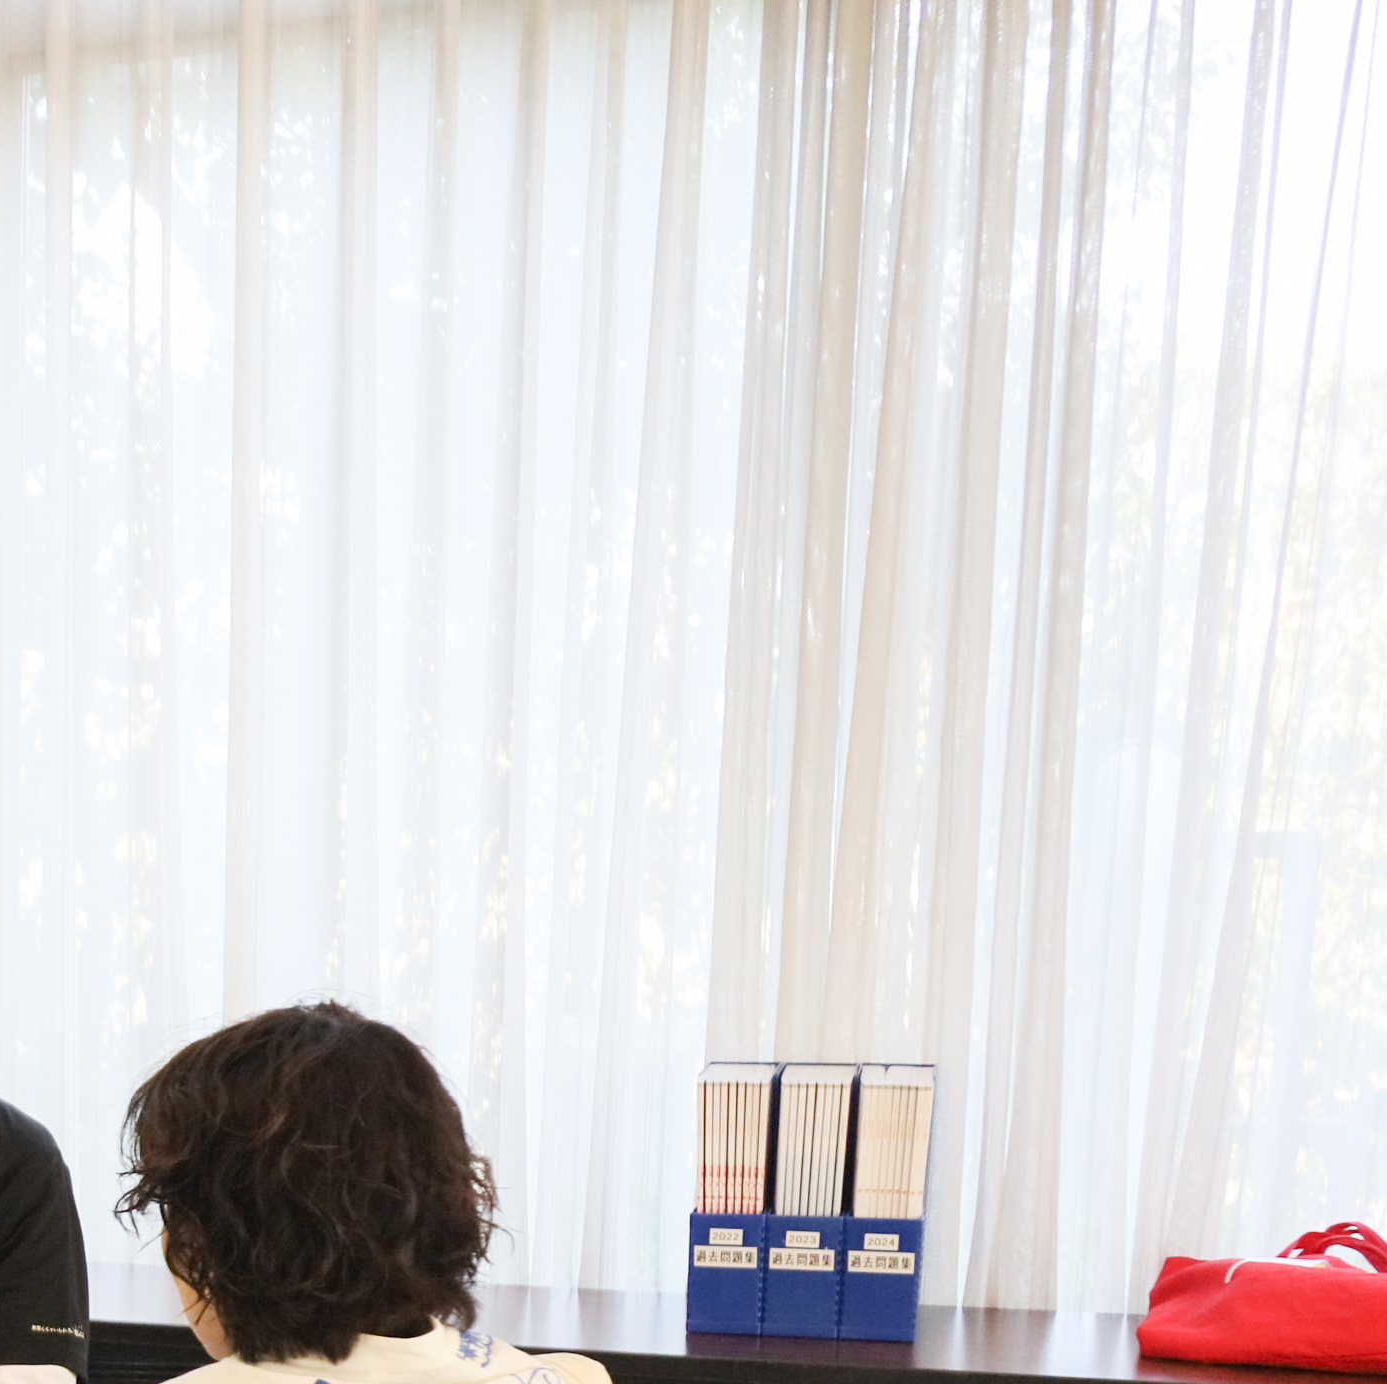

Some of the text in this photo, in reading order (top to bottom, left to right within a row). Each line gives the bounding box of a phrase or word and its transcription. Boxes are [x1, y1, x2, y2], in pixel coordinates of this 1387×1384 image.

[712, 1231, 740, 1241] 2022
[789, 1234, 817, 1244] 2023
[867, 1237, 895, 1247] 2024
[696, 1249, 756, 1264] 過去問題集
[771, 1251, 832, 1267] 過去問題集
[850, 1254, 912, 1270] 過去問題集
